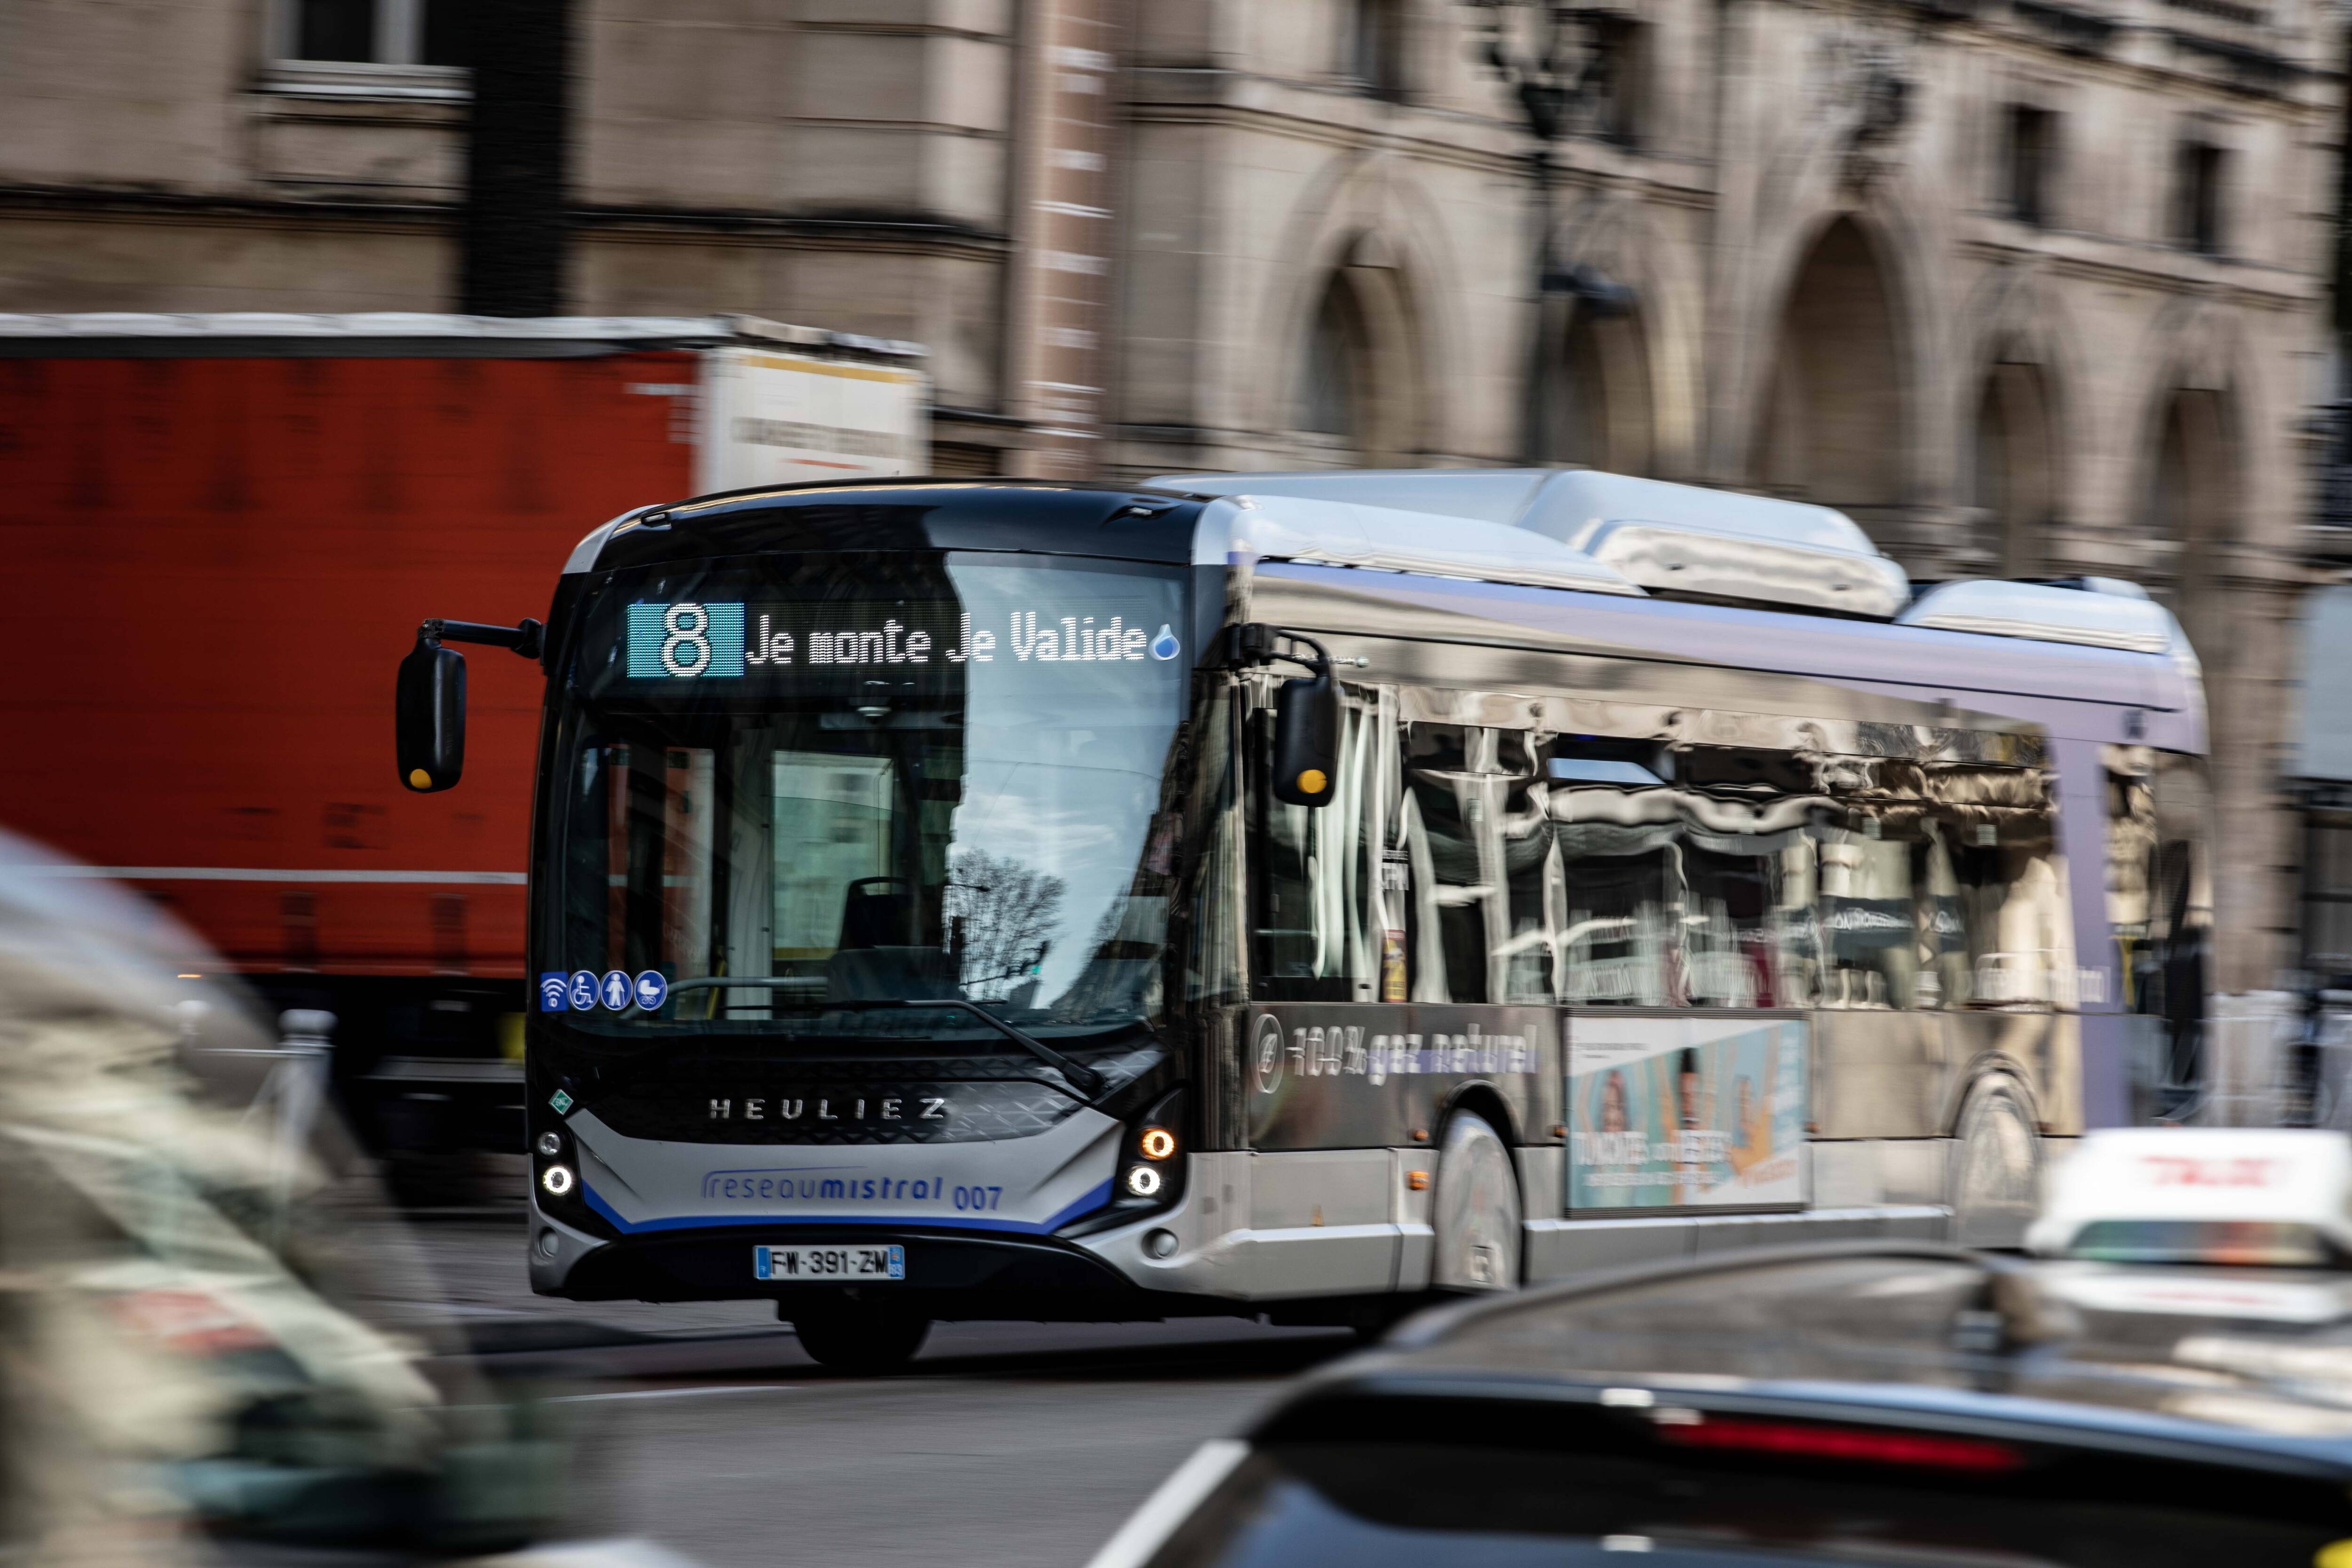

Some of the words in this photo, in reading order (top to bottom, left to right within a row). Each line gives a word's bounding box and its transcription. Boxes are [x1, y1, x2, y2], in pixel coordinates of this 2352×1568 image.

[661, 603, 711, 677] 8
[745, 615, 794, 664] Je
[809, 620, 931, 664] monte
[946, 613, 996, 662] Je
[1010, 612, 1147, 661] Valide
[709, 1098, 945, 1120] HEULIEZ
[954, 1186, 1003, 1211] 007
[770, 1250, 888, 1274] FW-391-ZM
